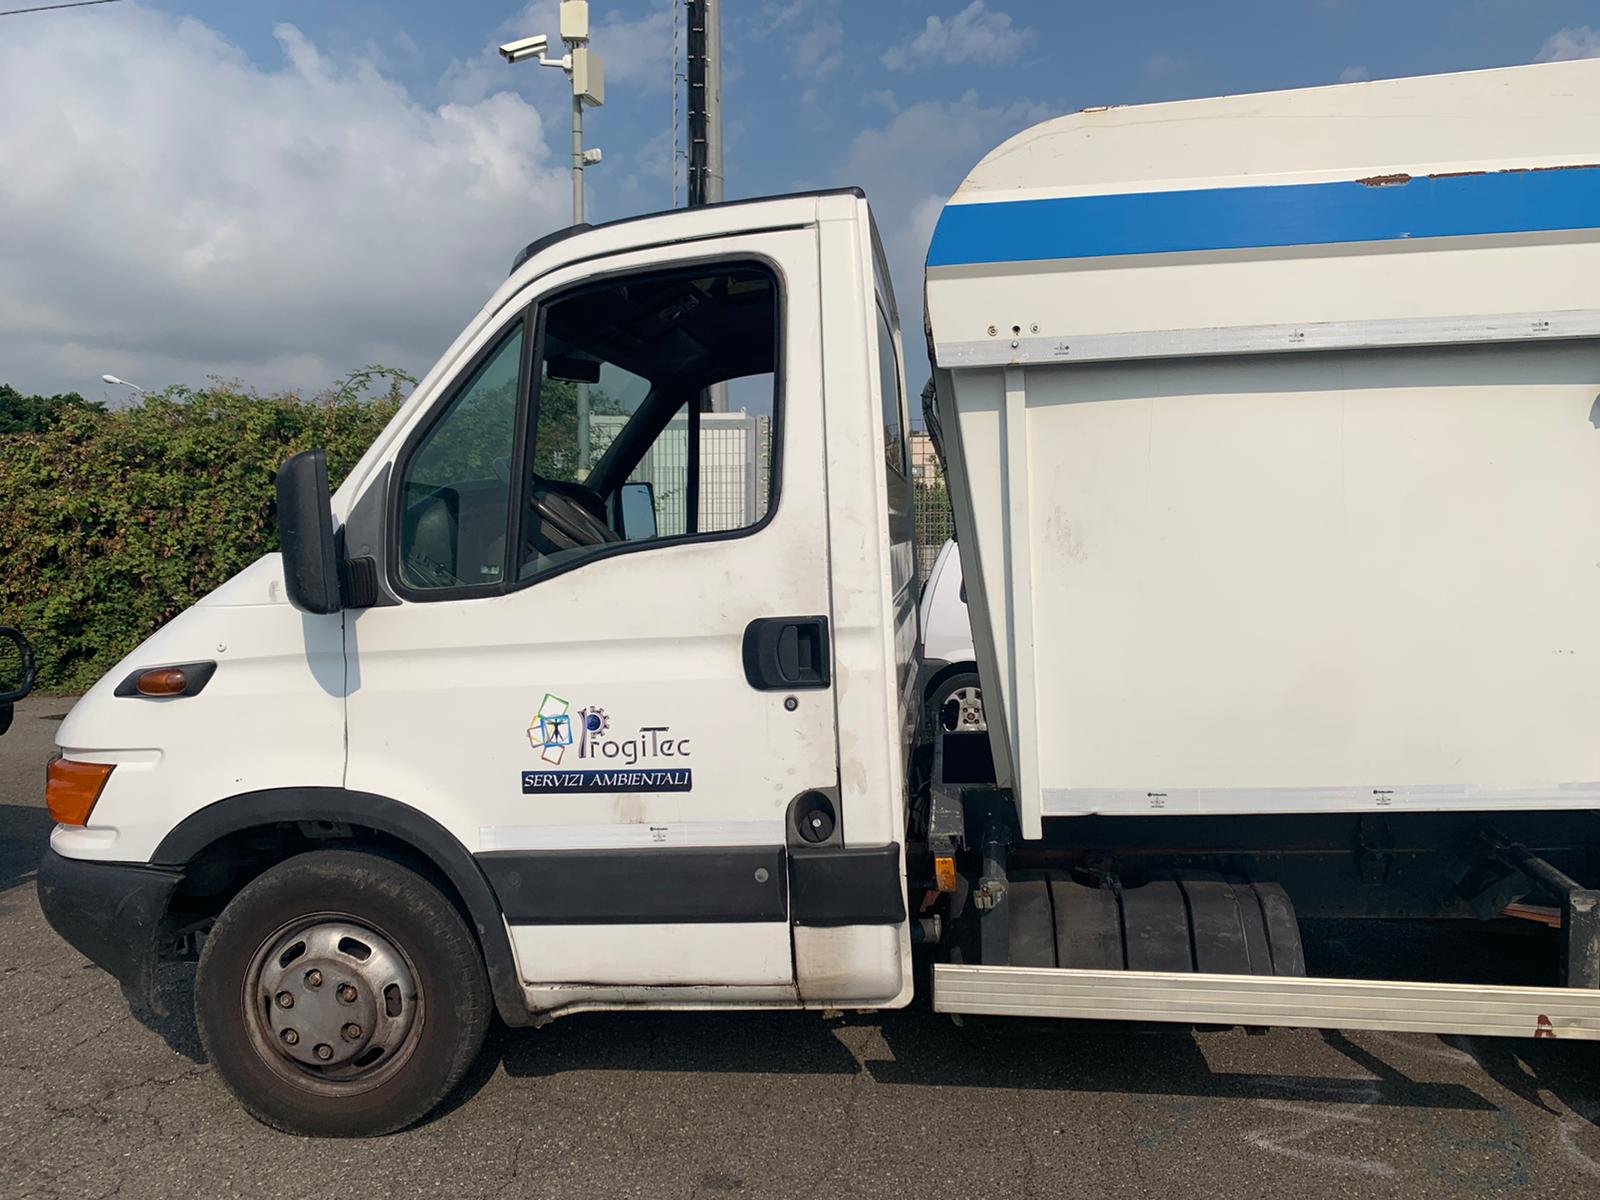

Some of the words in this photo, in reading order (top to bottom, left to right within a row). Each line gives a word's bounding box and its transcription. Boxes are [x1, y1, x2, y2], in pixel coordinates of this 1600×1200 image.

[577, 705, 691, 765] ProgiTec
[523, 773, 585, 788] SERVIZI
[589, 772, 690, 787] AMBIENTALI
